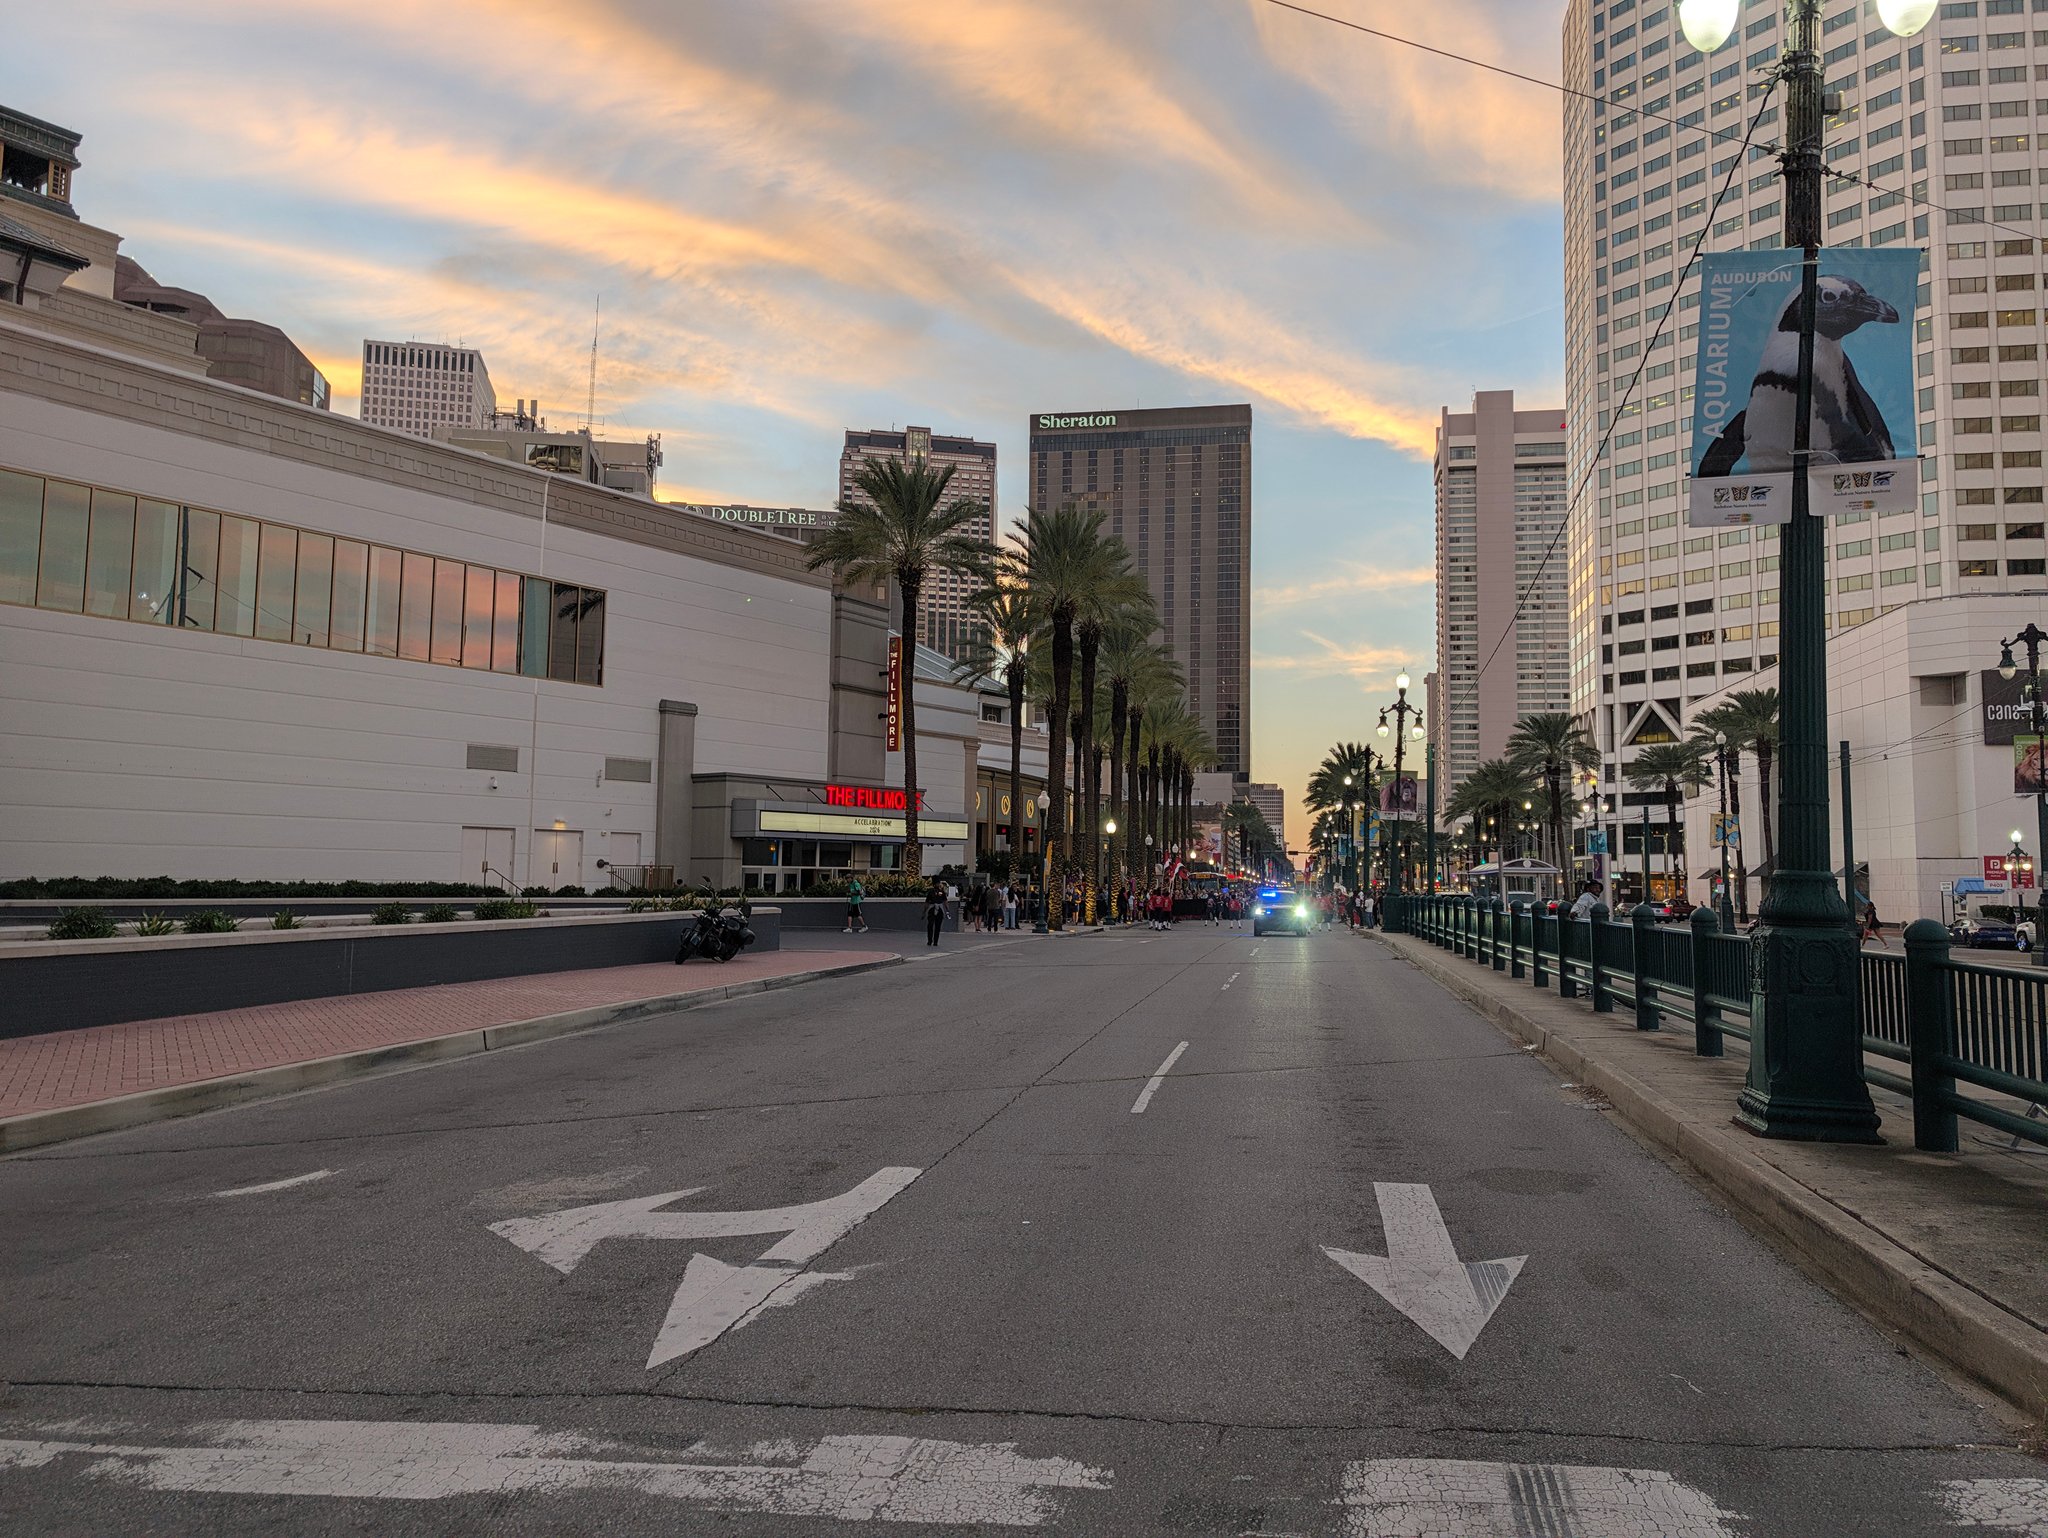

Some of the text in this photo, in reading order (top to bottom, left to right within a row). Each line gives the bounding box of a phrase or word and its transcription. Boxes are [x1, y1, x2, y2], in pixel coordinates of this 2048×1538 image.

[1711, 271, 1792, 285] AUDUBON
[1703, 287, 1733, 438] AQUARIUM
[1039, 414, 1117, 429] Sheraton
[889, 660, 897, 747] FILLMORE
[826, 785, 921, 811] THE FILLMOE
